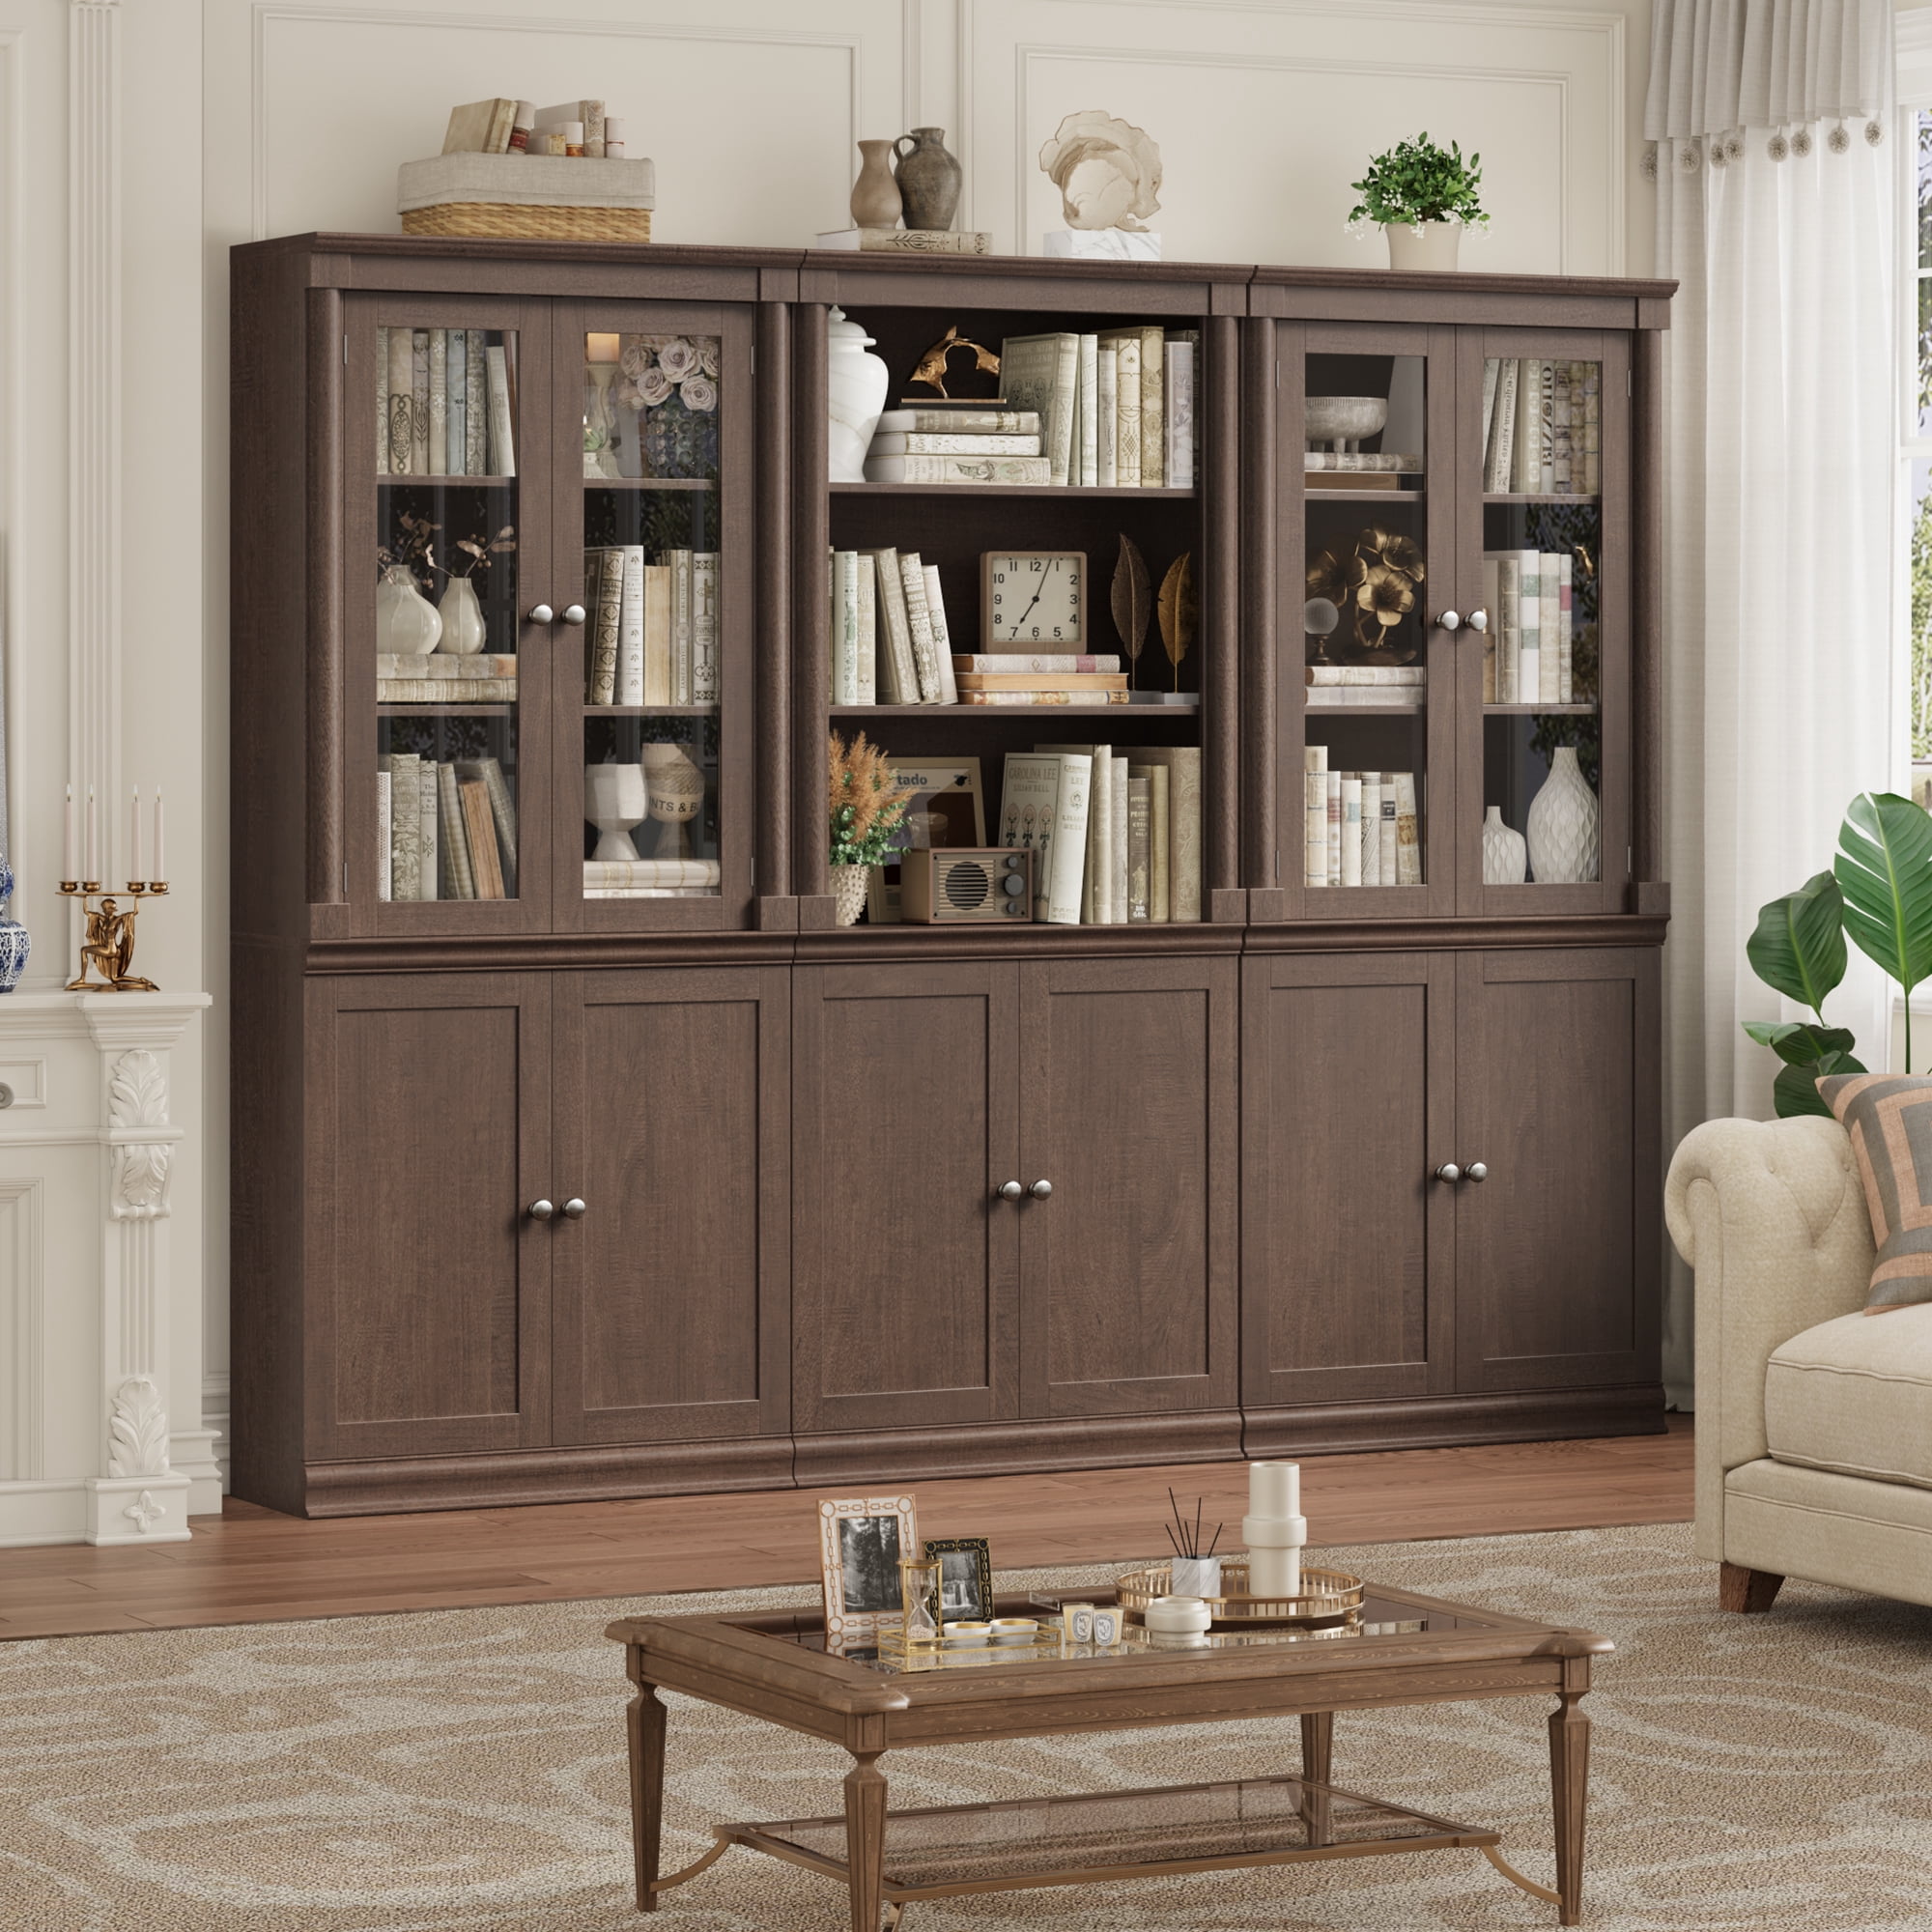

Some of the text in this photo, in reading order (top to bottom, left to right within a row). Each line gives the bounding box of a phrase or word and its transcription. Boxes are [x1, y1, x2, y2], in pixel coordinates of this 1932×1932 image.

[1009, 560, 1018, 572] 11
[1029, 560, 1042, 572] 12
[1055, 560, 1060, 572] 1
[993, 573, 1005, 584] 10
[1069, 574, 1078, 585] 2
[994, 593, 1002, 605] 9
[1069, 594, 1078, 605] 3
[994, 613, 1002, 624] 8
[1069, 613, 1078, 624] 4
[1009, 626, 1018, 638] 7
[1032, 626, 1040, 638] 6
[1053, 626, 1061, 638] 5
[1043, 767, 1057, 781] LEE
[678, 802, 687, 812] &
